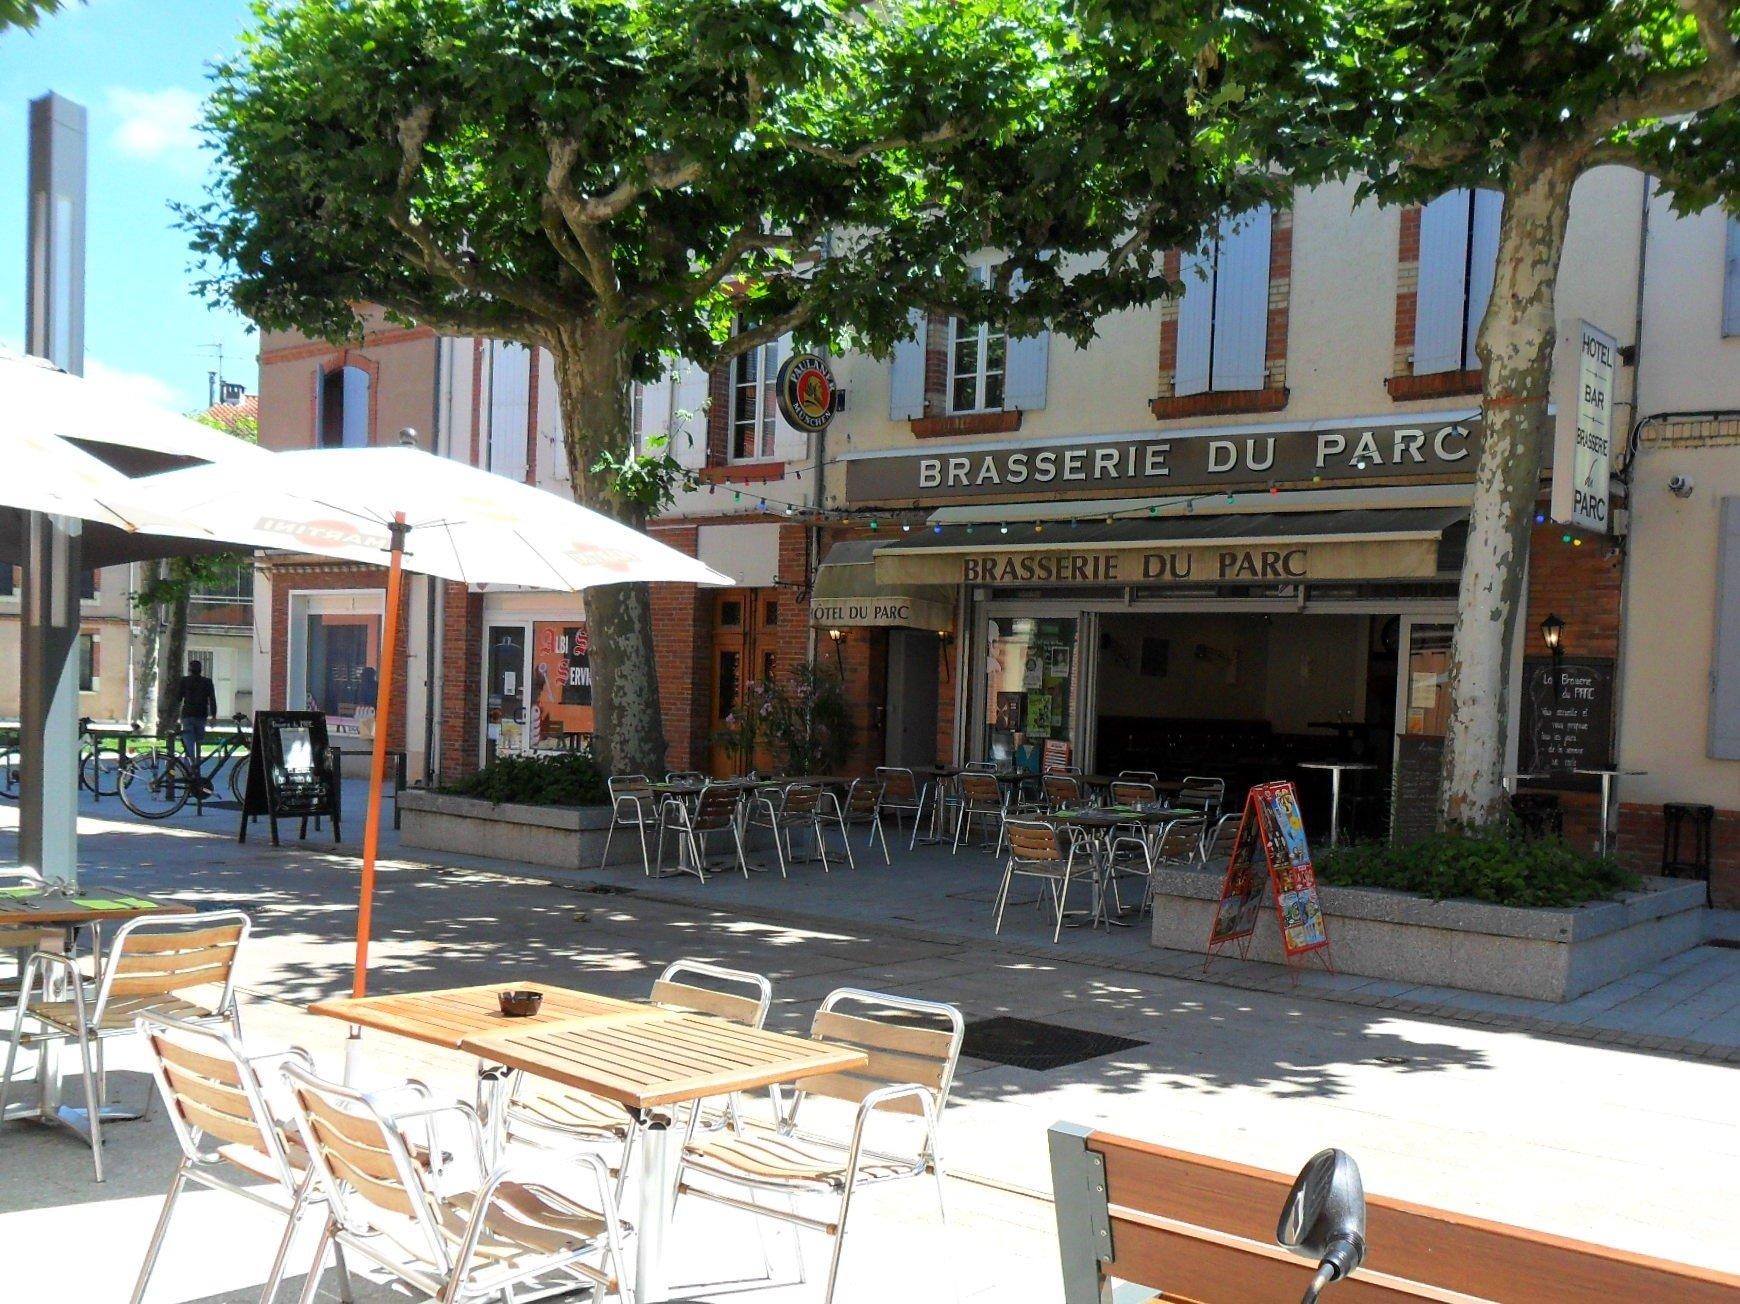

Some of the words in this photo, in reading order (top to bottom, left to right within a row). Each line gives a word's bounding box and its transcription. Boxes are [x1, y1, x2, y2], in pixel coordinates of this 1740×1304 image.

[1581, 337, 1613, 369] HOTEL
[1584, 384, 1605, 411] BAR
[919, 443, 1172, 489] BRASSERIE
[1207, 437, 1278, 474] DU
[1314, 426, 1471, 469] PARC
[1576, 427, 1609, 459] BRASSERIE
[1573, 489, 1606, 523] PARC
[963, 555, 1119, 582] BRASSERIE
[1143, 553, 1192, 579] DU
[1218, 550, 1307, 578] PARC
[848, 605, 868, 620] DU
[873, 604, 910, 620] PARC
